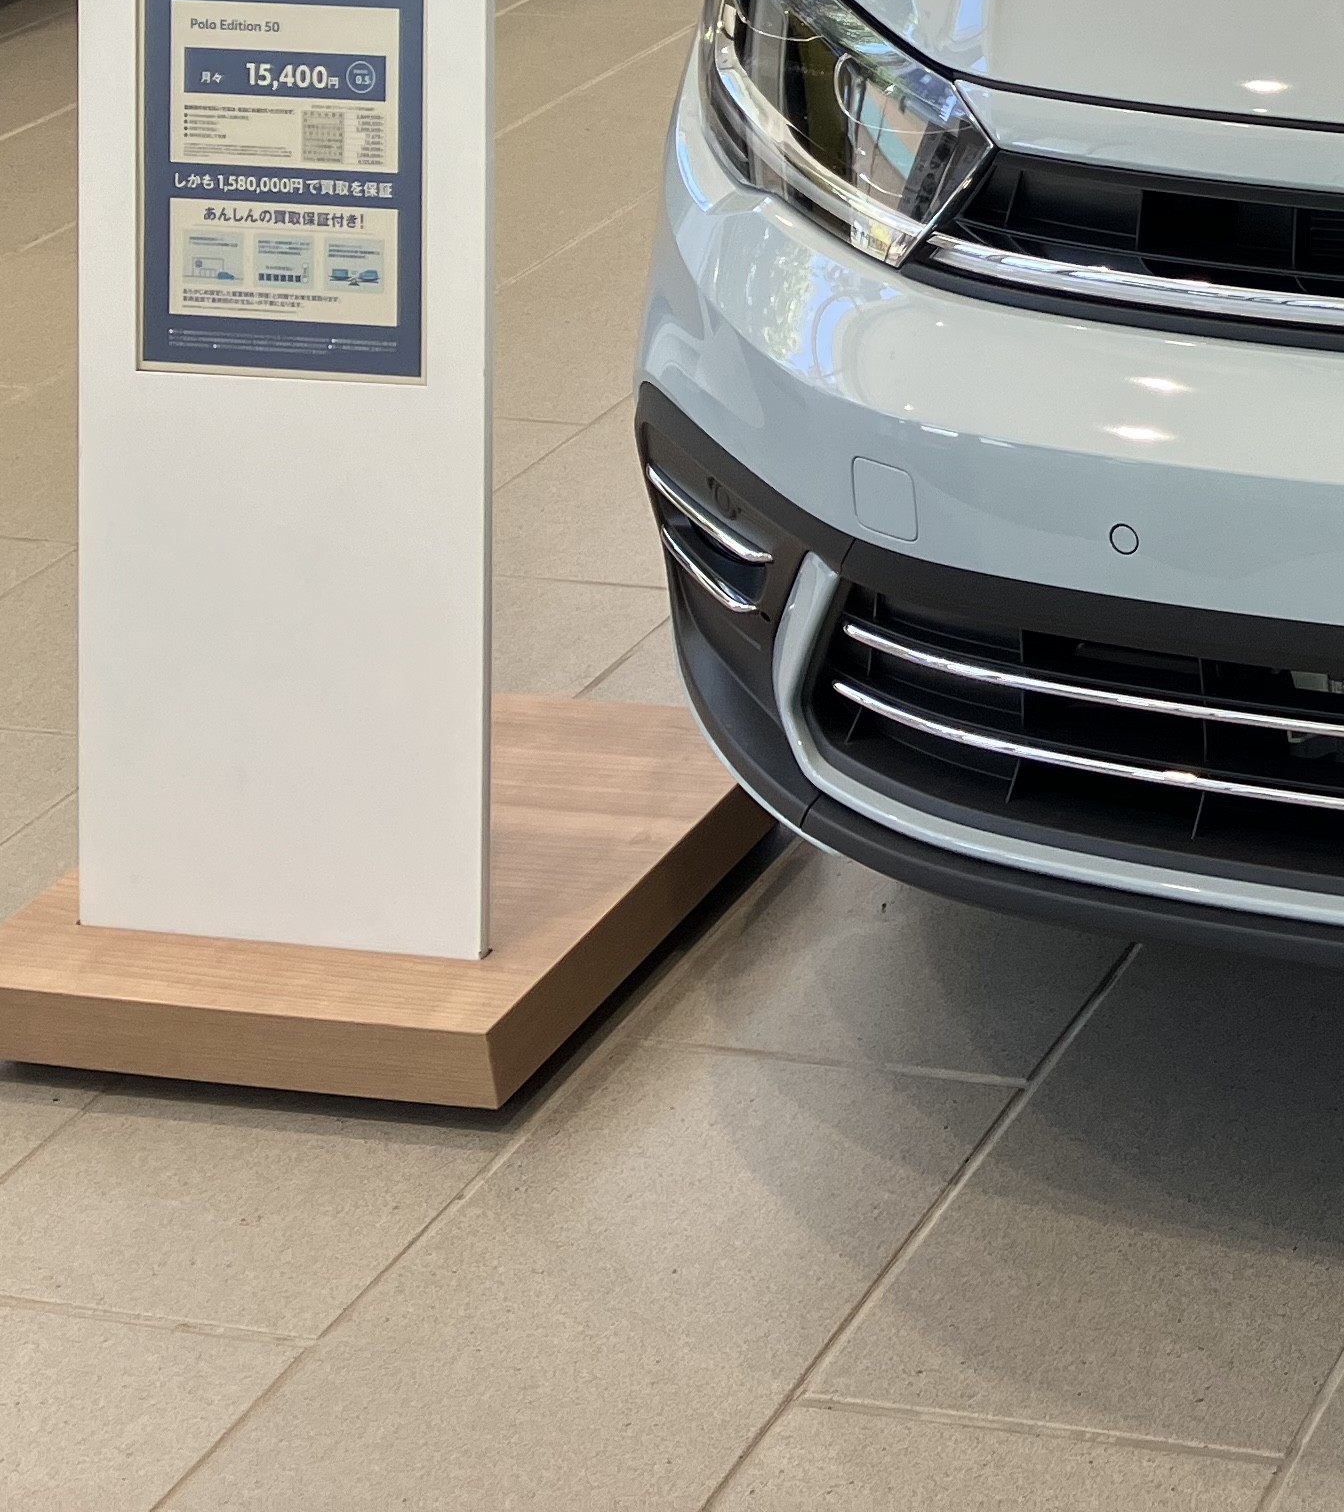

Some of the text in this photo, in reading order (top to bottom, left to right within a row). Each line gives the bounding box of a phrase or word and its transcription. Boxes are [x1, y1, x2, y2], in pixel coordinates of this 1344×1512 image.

[190, 18, 280, 33] Polo Edition 50
[200, 71, 223, 84] 月々
